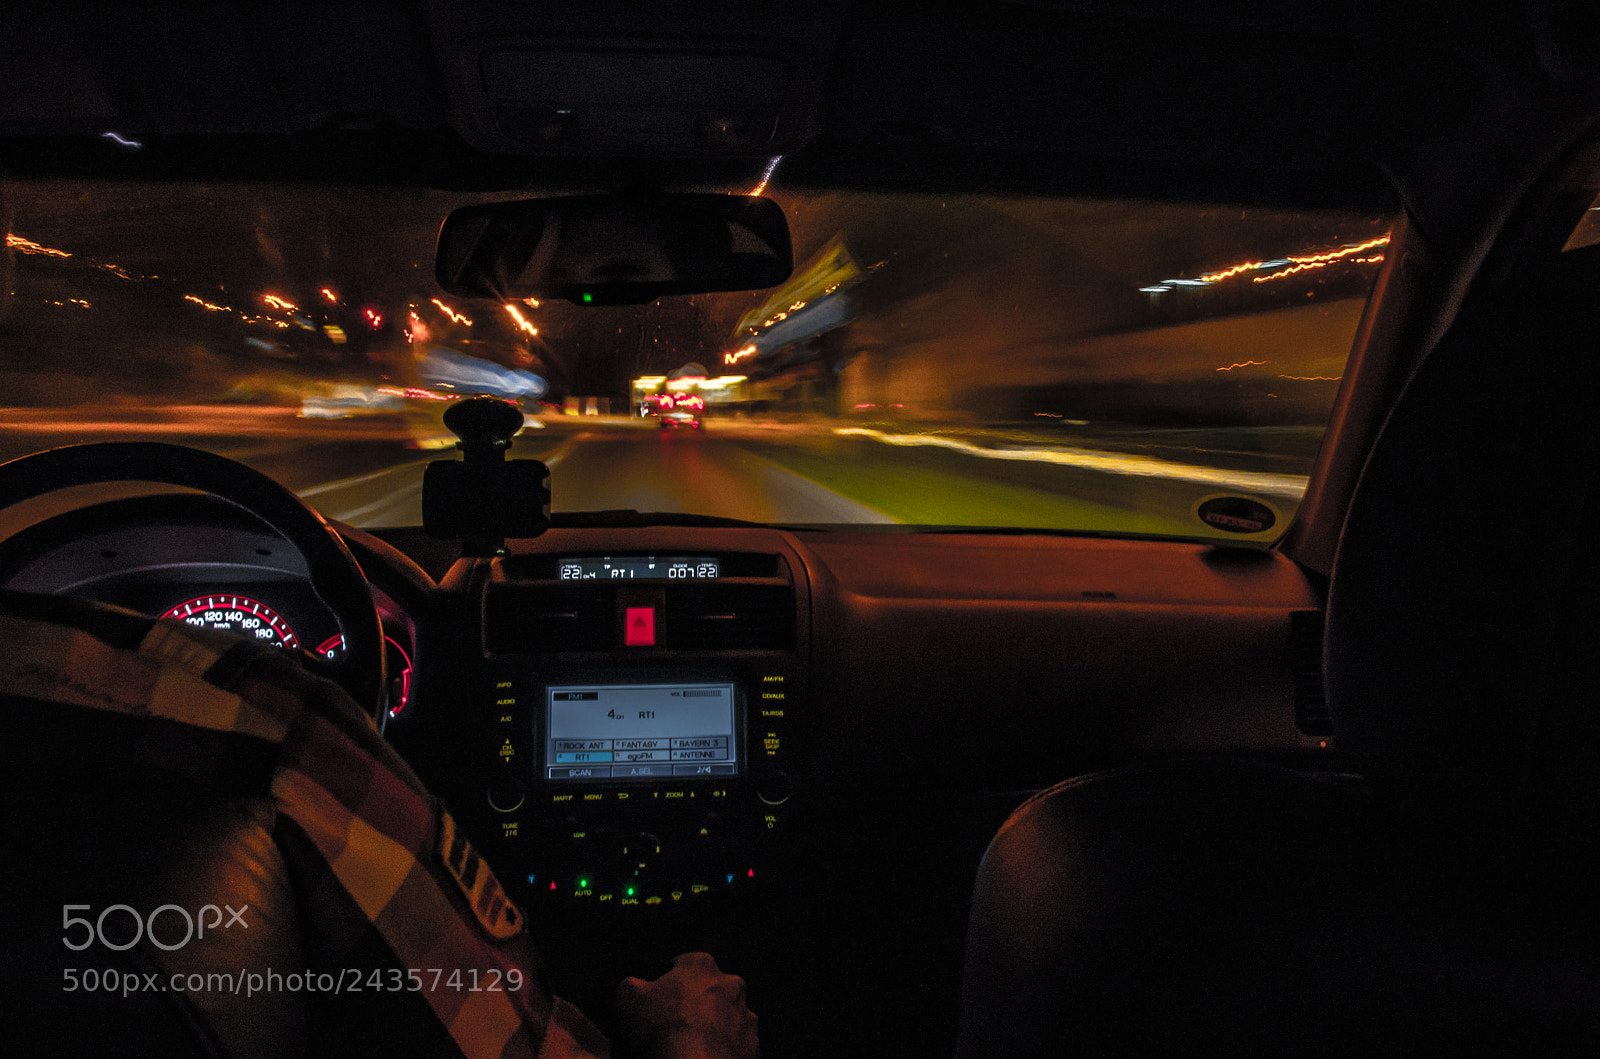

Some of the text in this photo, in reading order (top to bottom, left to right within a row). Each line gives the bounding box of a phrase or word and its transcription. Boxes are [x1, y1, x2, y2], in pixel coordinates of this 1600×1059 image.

[563, 568, 580, 579] 22
[699, 568, 716, 578] 22
[204, 611, 223, 622] 120
[224, 611, 243, 622] 140
[242, 618, 260, 628] 160
[255, 628, 274, 638] 180
[327, 650, 335, 659] 0
[607, 709, 616, 720] 4
[638, 711, 655, 720] RT1
[679, 740, 710, 748] BAYERN
[713, 740, 719, 748] 3
[628, 752, 653, 762] egoFM
[679, 751, 715, 759] ANTENNE
